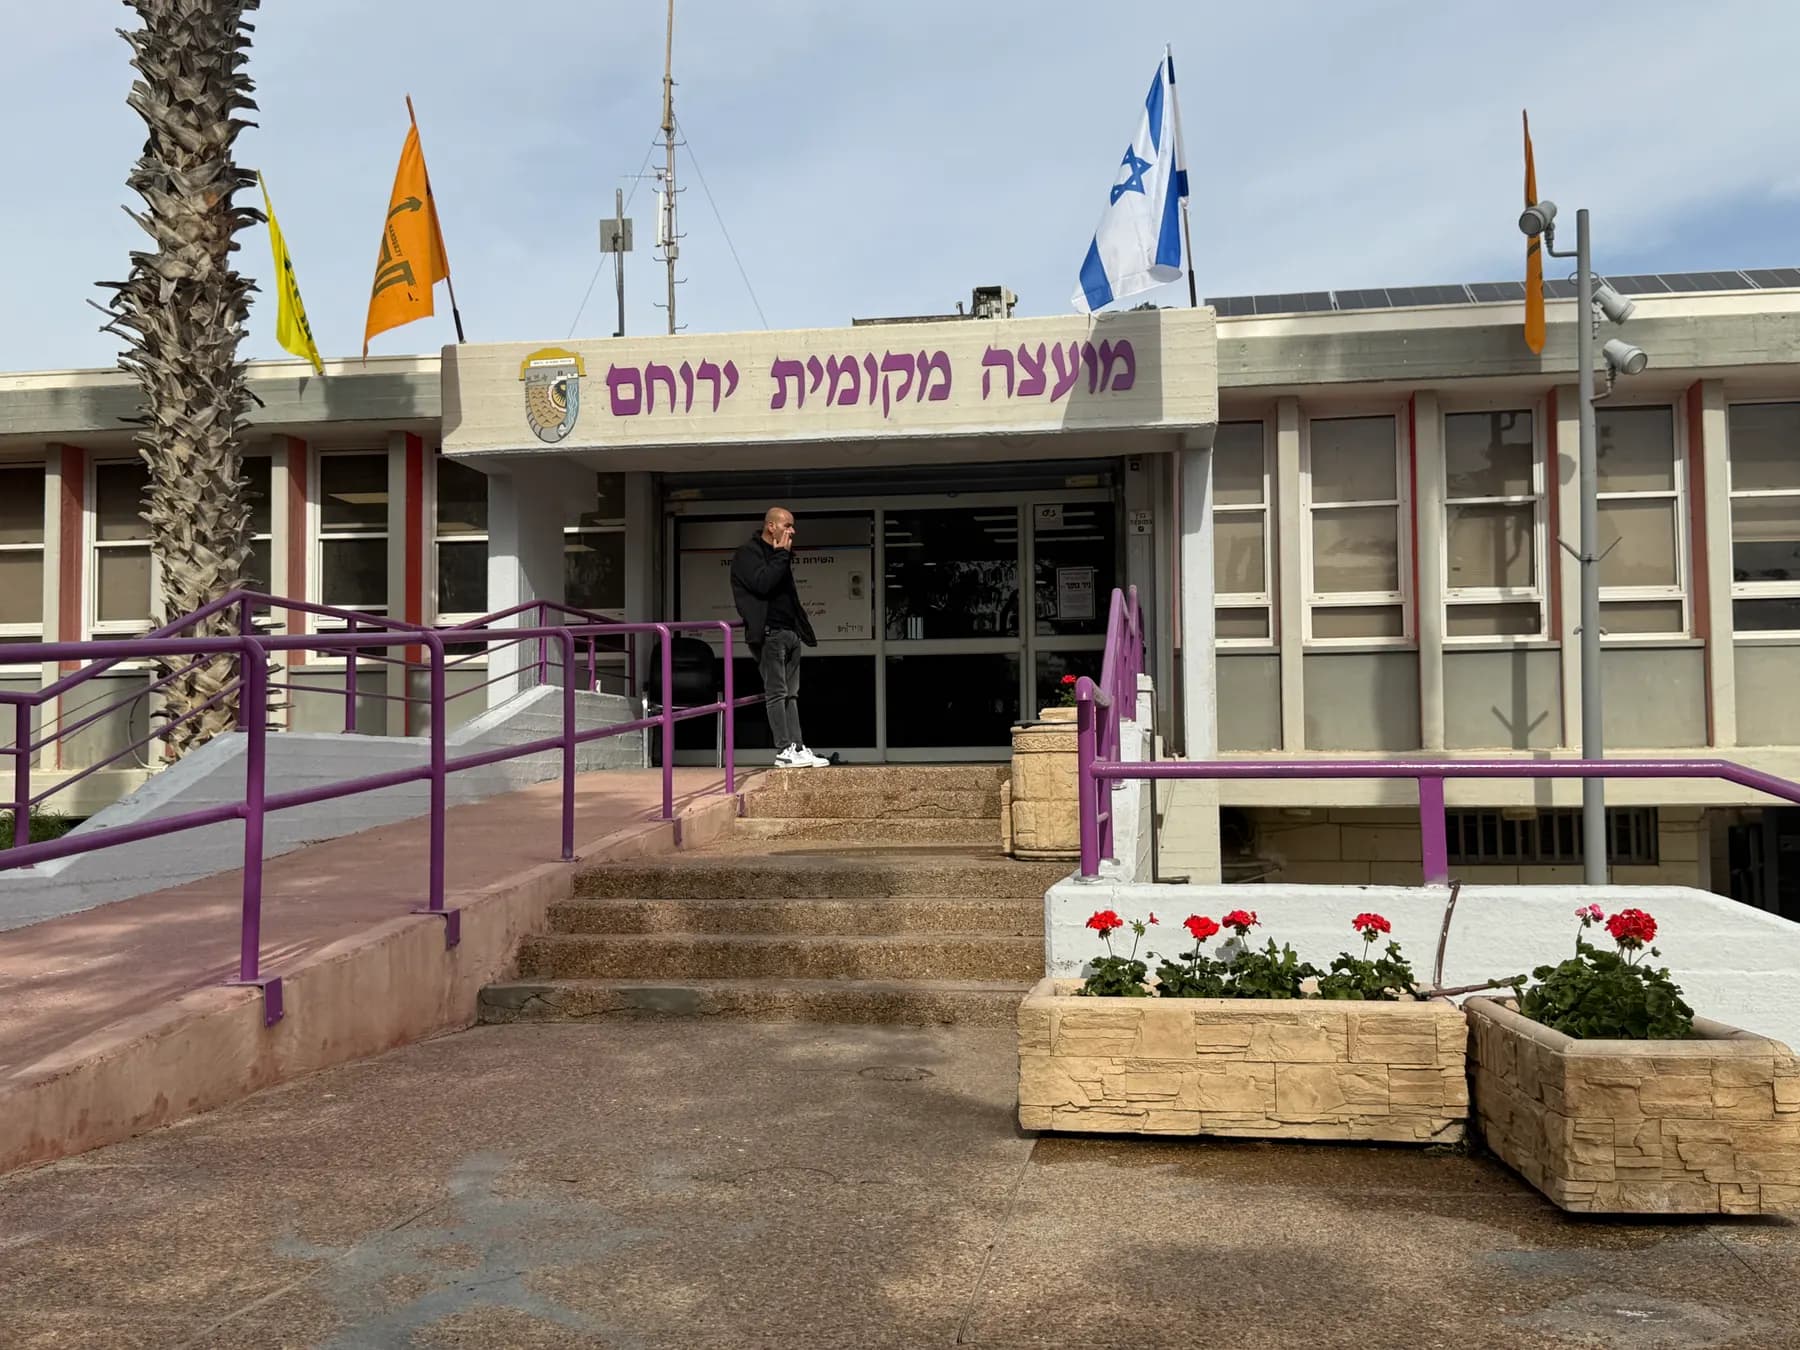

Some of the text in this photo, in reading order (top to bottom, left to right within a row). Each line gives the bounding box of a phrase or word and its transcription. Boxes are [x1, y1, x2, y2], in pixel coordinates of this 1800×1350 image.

[605, 339, 1136, 419] מועצה מקומית ירוחם
[803, 555, 834, 565] השירות
